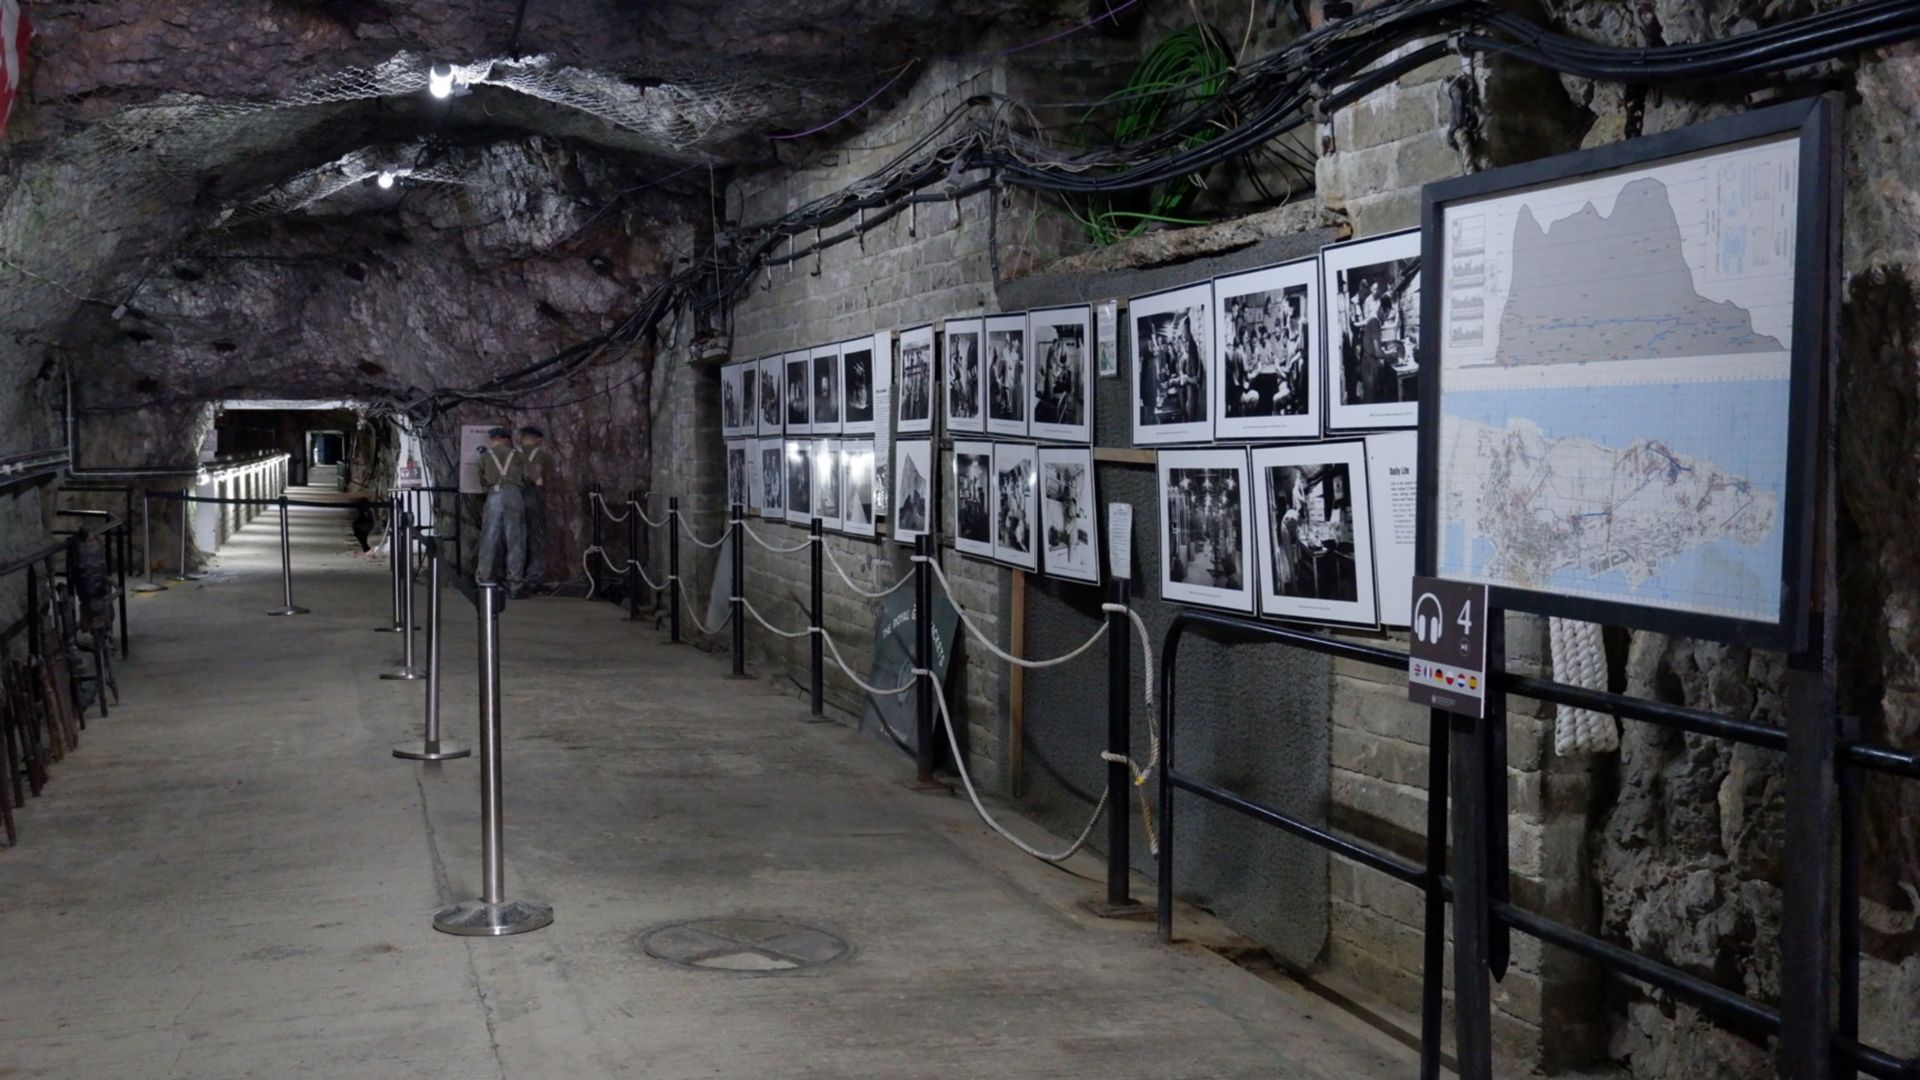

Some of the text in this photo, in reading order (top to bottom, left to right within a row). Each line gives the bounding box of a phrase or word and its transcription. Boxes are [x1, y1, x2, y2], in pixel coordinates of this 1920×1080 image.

[1401, 466, 1410, 475] Life
[892, 609, 910, 629] ROYAL
[1457, 599, 1472, 635] 4
